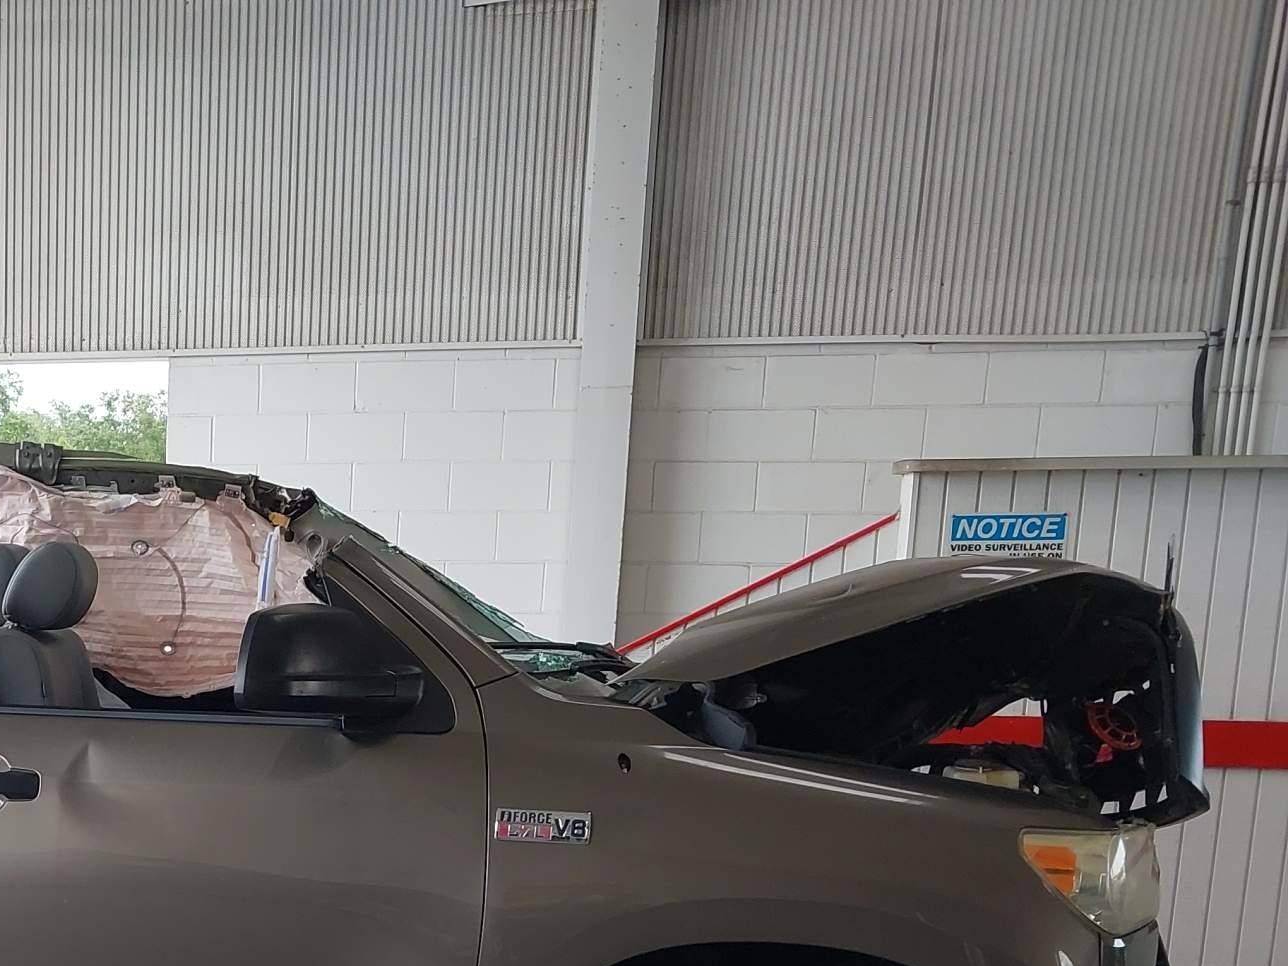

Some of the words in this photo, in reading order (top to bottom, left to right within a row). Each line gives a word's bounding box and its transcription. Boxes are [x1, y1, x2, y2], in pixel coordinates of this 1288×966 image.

[955, 517, 1062, 539] NOTICE
[951, 543, 982, 552] VIDEO
[984, 542, 1064, 552] SURVEILLANCE
[553, 817, 588, 838] V8
